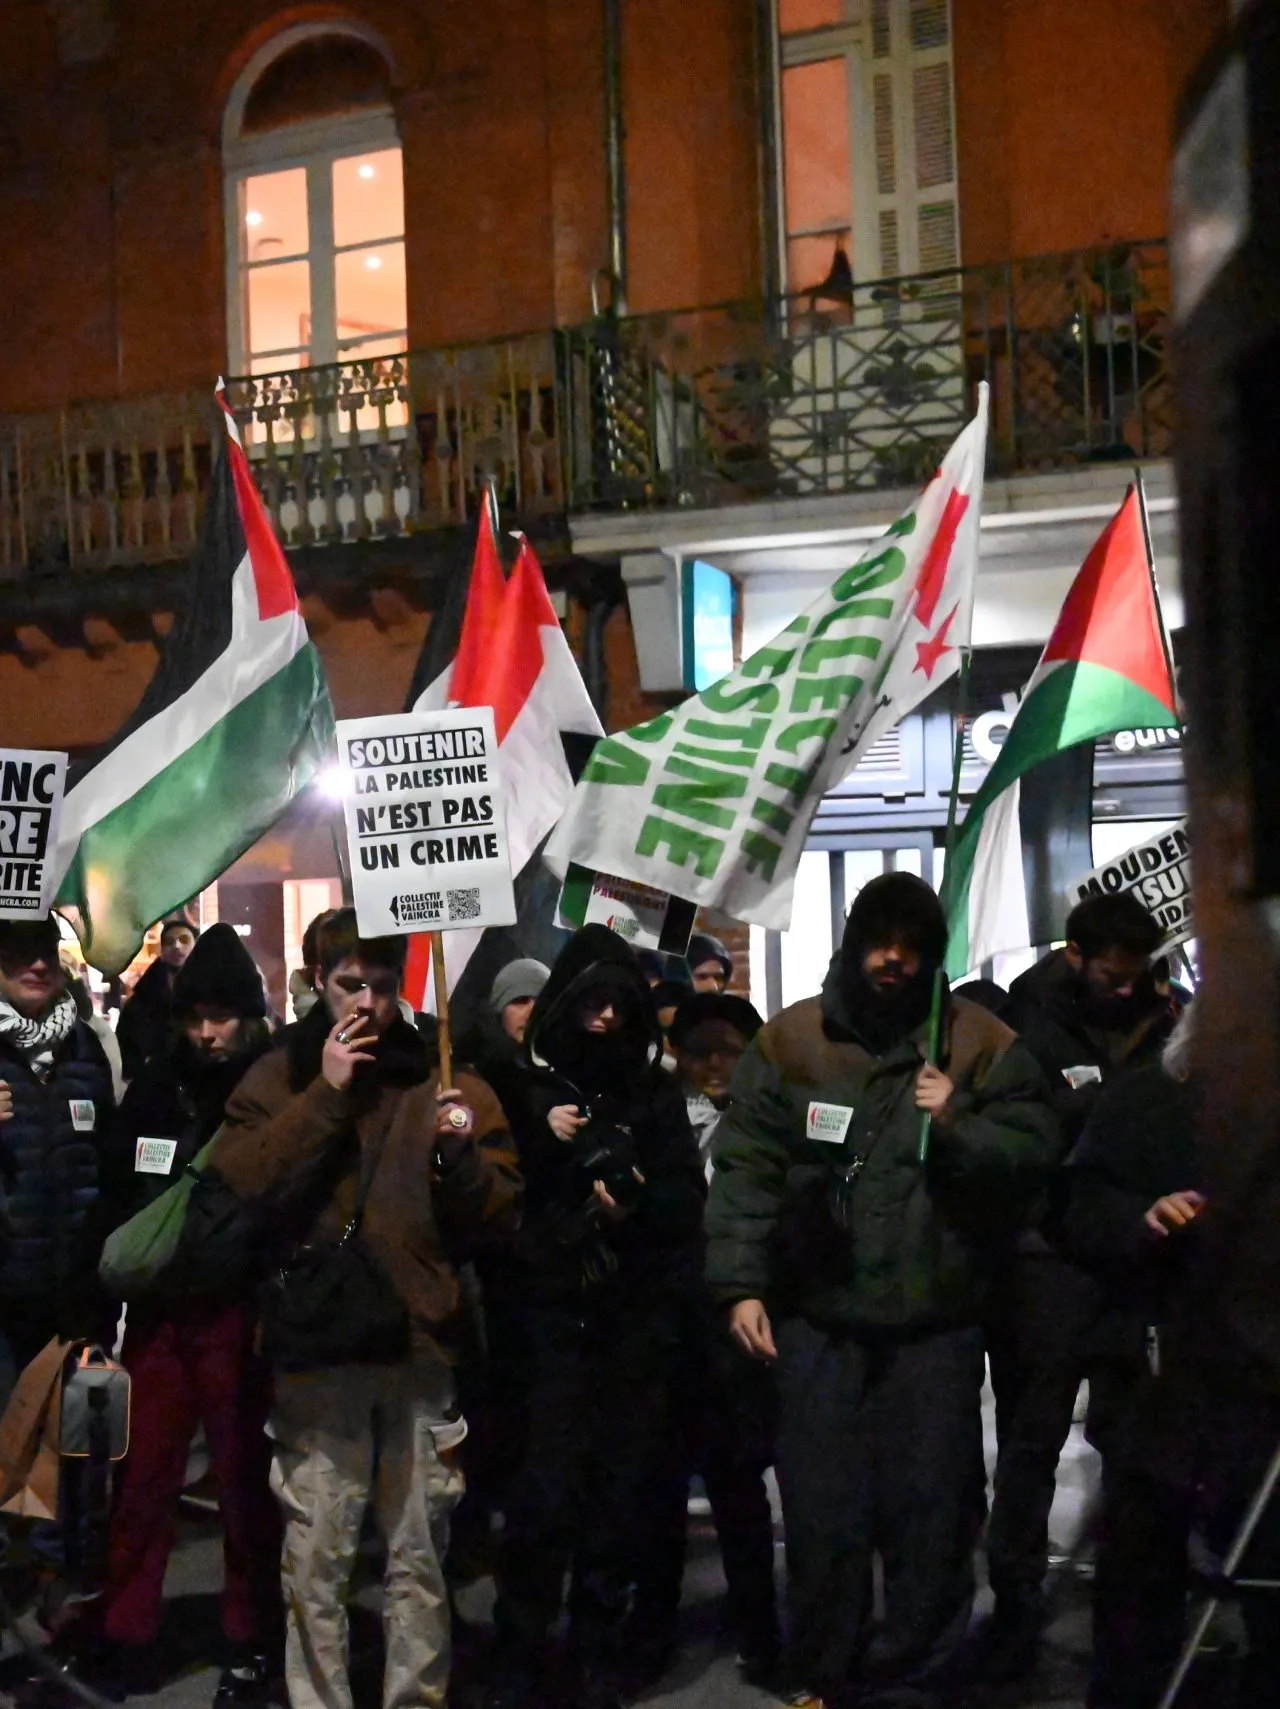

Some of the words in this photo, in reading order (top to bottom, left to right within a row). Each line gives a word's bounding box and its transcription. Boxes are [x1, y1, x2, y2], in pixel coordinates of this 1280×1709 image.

[350, 729, 485, 768] SOUTENIR
[635, 615, 812, 880] ESTINE
[354, 774, 379, 794] LA
[386, 764, 488, 791] PALESTINE
[356, 801, 432, 833] N'EST
[442, 795, 494, 824] PAS
[360, 843, 400, 871] UN
[410, 834, 499, 866] CRIME
[1077, 830, 1192, 900] MOUDEN
[400, 892, 441, 903] COLLECTIF
[401, 900, 444, 912] PALESTINE
[402, 909, 441, 921] VAINCRA
